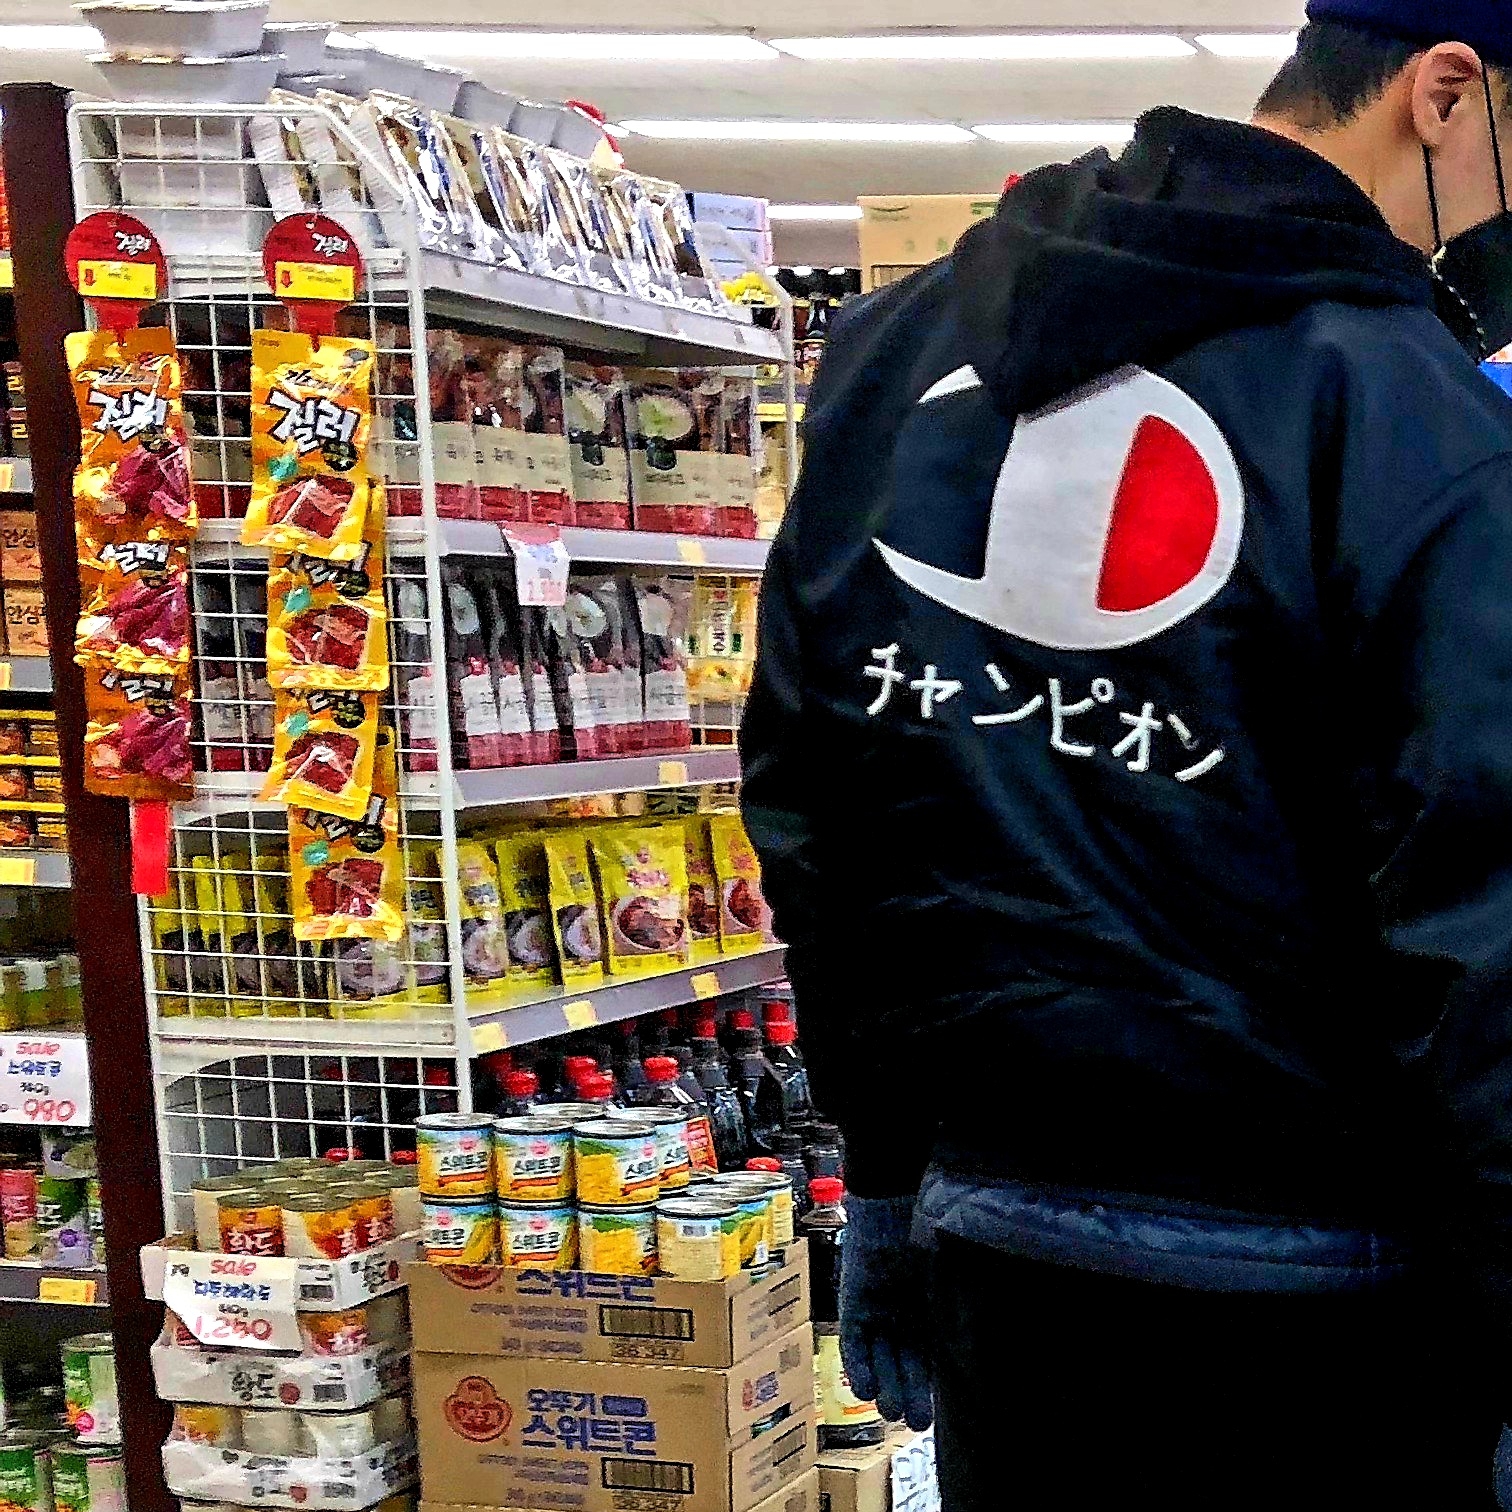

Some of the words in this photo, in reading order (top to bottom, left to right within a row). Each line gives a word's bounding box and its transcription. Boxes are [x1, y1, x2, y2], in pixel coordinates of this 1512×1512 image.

[88, 388, 168, 442] 질러
[264, 386, 360, 454] 질러
[863, 643, 1226, 782] チャンピオン
[527, 1388, 597, 1415] 오뚜기
[521, 1415, 657, 1456] 스위트콘
